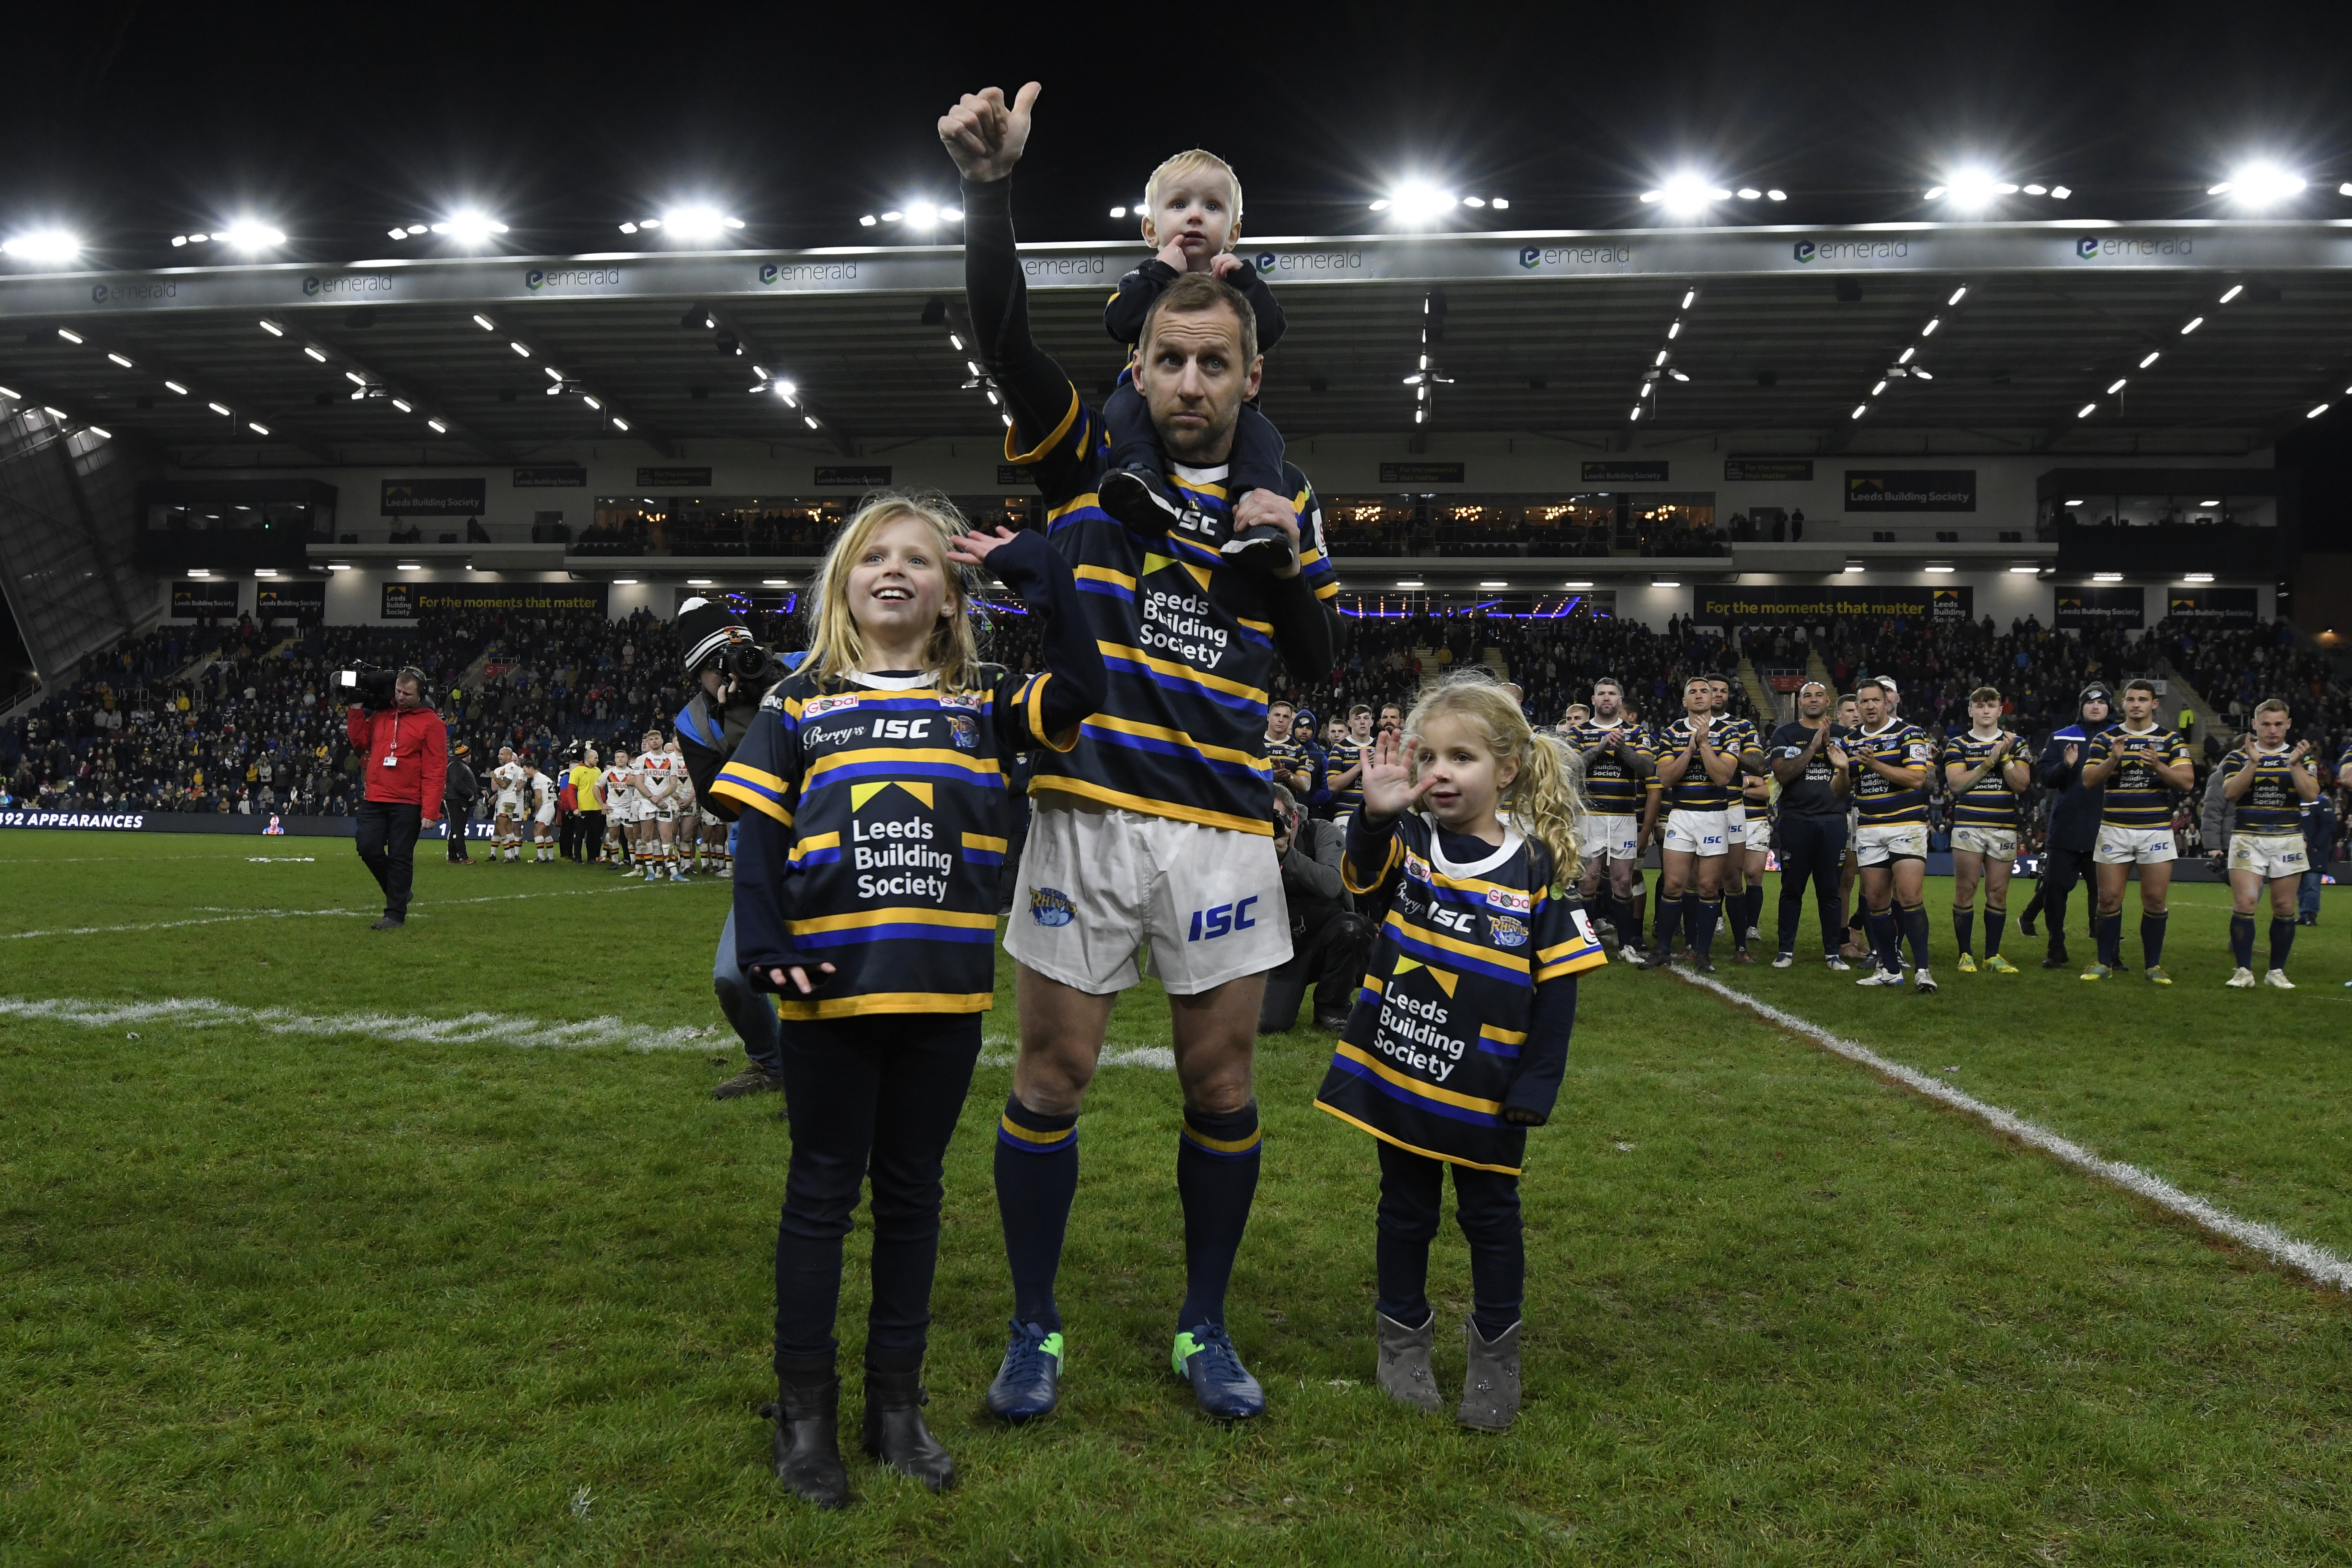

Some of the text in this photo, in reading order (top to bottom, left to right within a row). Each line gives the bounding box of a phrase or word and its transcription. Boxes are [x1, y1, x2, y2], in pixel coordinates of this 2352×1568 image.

[1820, 238, 1907, 259] emerald
[2103, 236, 2191, 254] emerald
[1280, 250, 1361, 270] emerald
[1545, 244, 1629, 264] emerald
[781, 261, 856, 280] emerald
[1026, 256, 1103, 275] emerald
[323, 274, 391, 292] emerald
[547, 267, 618, 286] emerald
[111, 282, 176, 299] emerald
[386, 498, 479, 508] Leeds Building Society
[1851, 491, 1969, 503] Leeds Building Society
[387, 602, 412, 610] Building
[419, 596, 598, 608] For the moments that matter
[1706, 601, 1925, 615] For the moments that matter
[1933, 608, 1966, 617] Building
[2082, 608, 2111, 616] Building
[2112, 608, 2140, 616] Society
[2195, 609, 2224, 618] Building
[2225, 609, 2254, 617] Society
[1140, 624, 1223, 670] Society
[803, 723, 868, 751] Berry's
[871, 718, 931, 739] ISC
[1593, 764, 1622, 772] Building
[1860, 778, 1890, 787] Building
[1861, 786, 1889, 794] Society
[2253, 798, 2286, 806] Society
[2254, 792, 2287, 800] Building
[27, 814, 143, 828] APPEARANCES
[852, 816, 934, 842] Leeds
[1703, 836, 1722, 844] ISC
[2000, 842, 2016, 850] ISC
[2150, 841, 2169, 851] ISC
[854, 843, 953, 876] Building
[2282, 852, 2303, 863] ISC
[857, 871, 948, 904] Society
[1188, 895, 1258, 942] ISC
[1426, 901, 1476, 934] ISC
[1384, 980, 1448, 1024] Leeds
[1379, 1004, 1465, 1061] Building
[1373, 1027, 1455, 1082] Society
